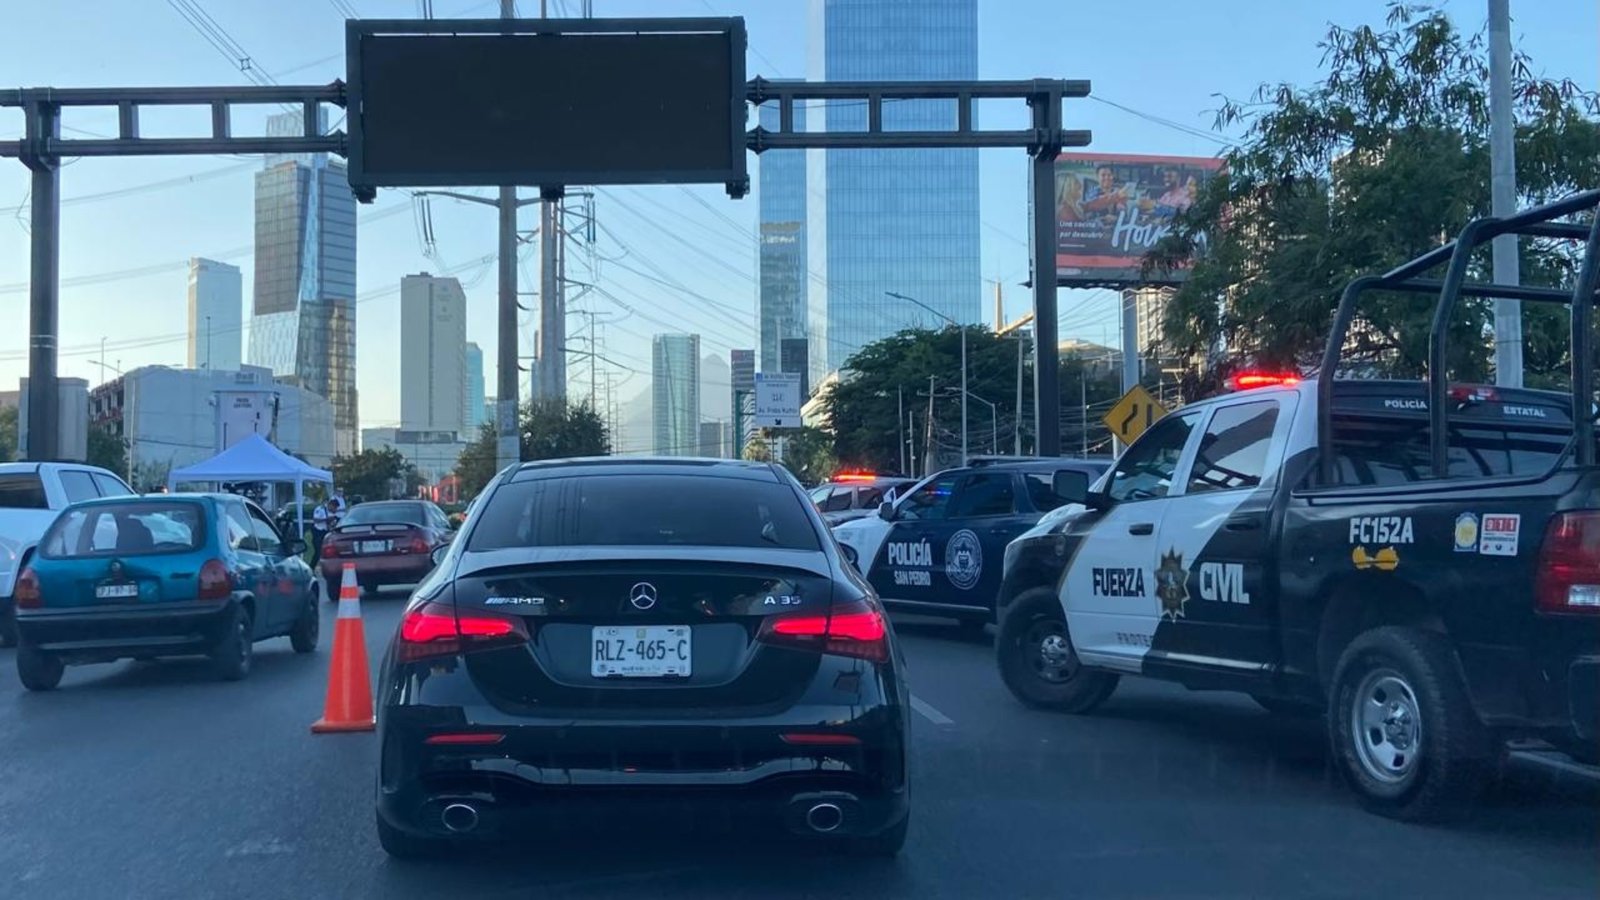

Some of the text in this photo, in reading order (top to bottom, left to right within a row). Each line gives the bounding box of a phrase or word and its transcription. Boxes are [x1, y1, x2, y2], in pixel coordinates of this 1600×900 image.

[1503, 405, 1546, 418] ESTATAL
[1349, 516, 1415, 544] FC152A
[888, 538, 932, 566] POLICÍA
[894, 570, 931, 586] SAN PEDRO
[1092, 562, 1250, 604] FUERZA CIVIL
[764, 595, 801, 605] A 35
[595, 639, 688, 661] RLZ-465-C
